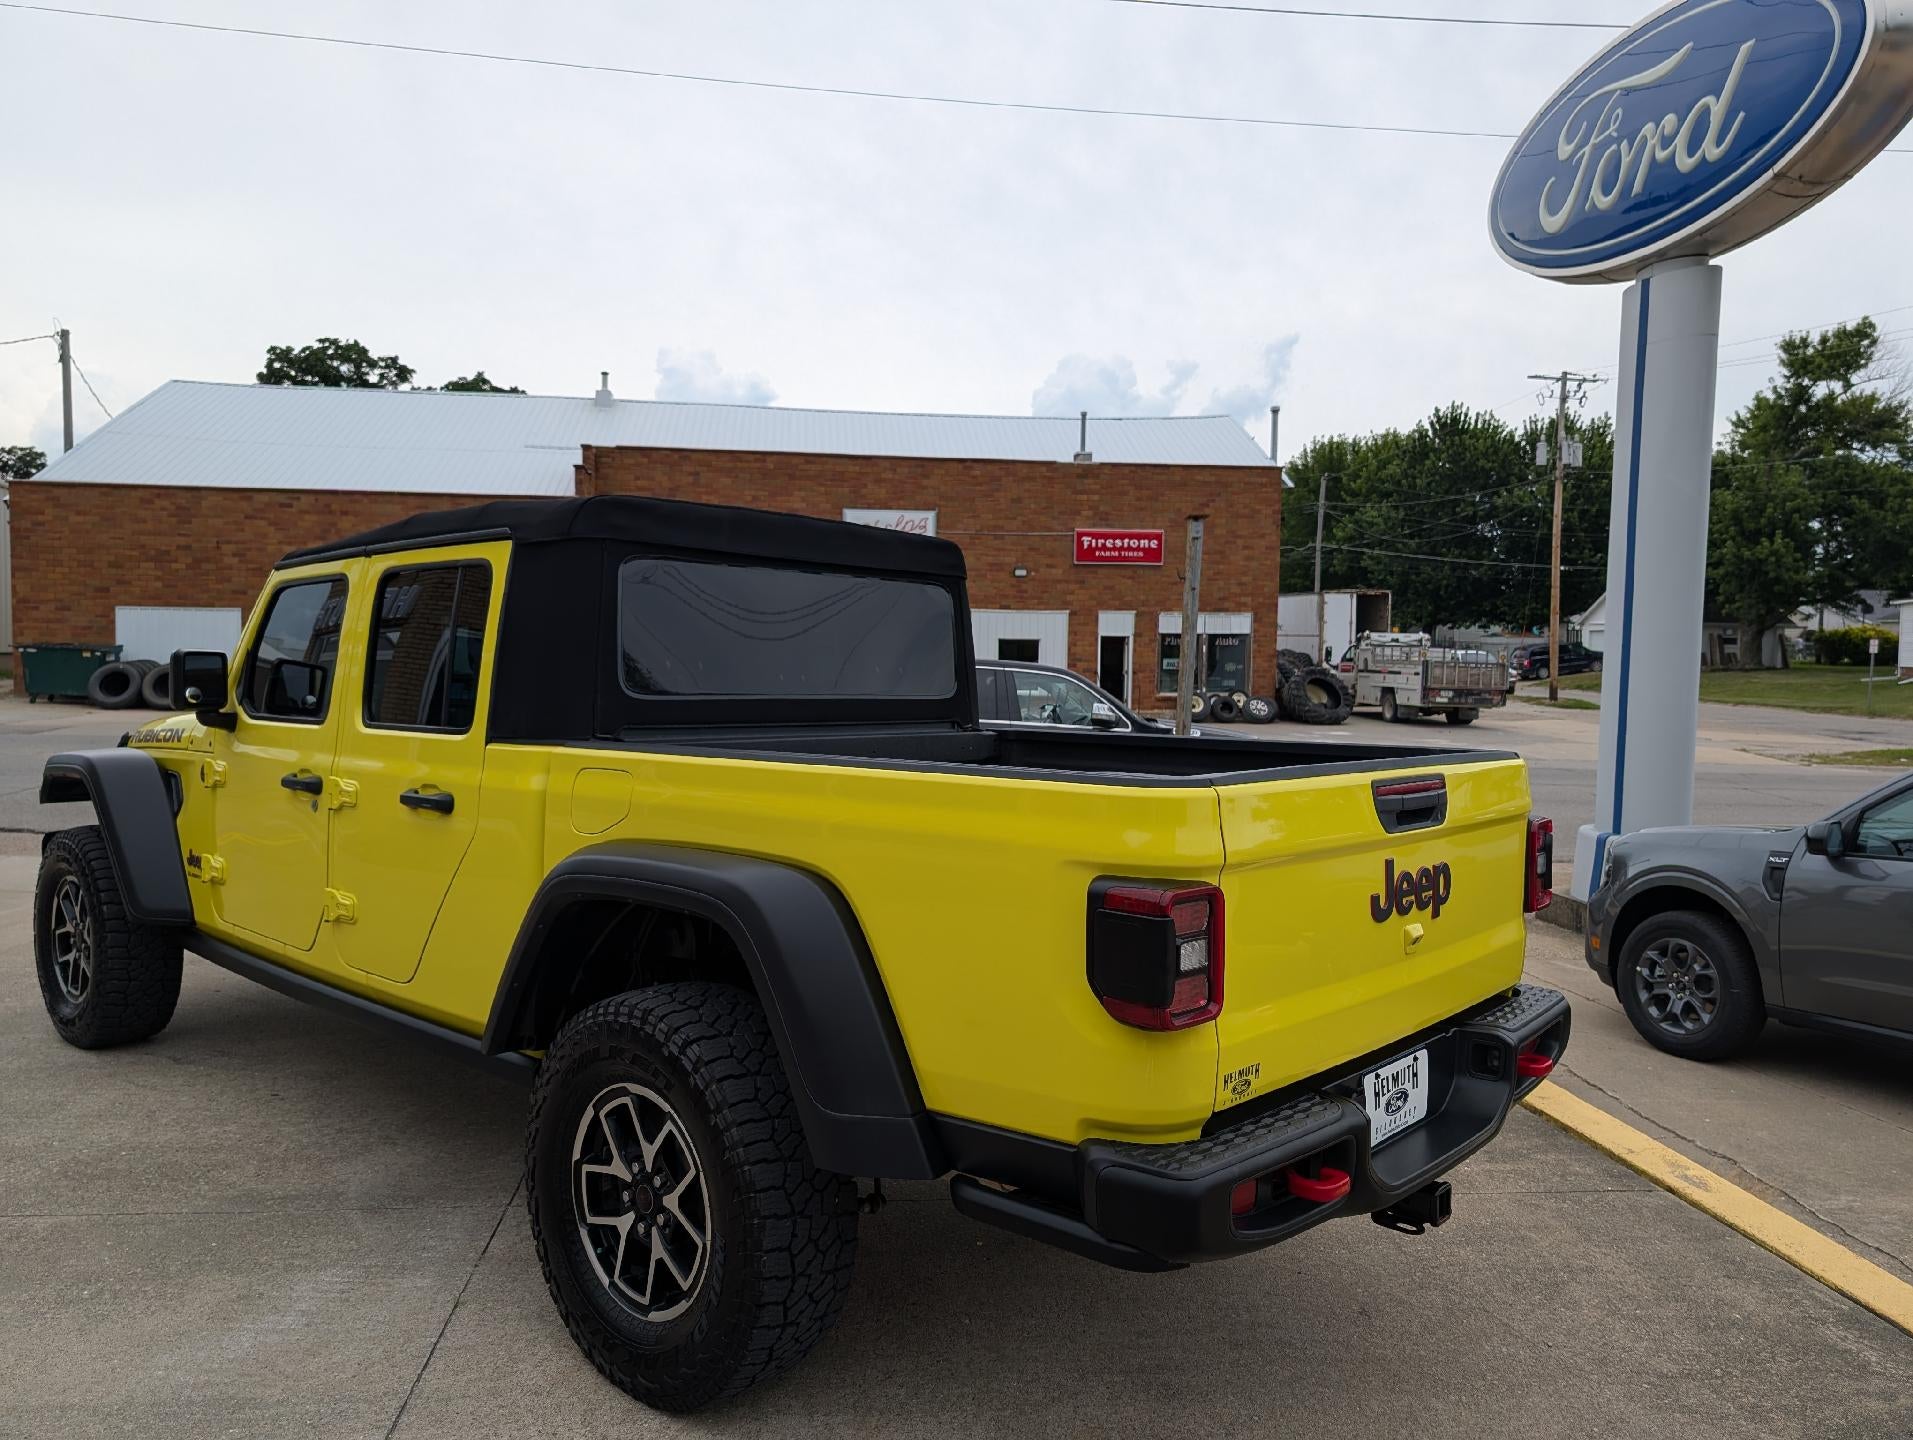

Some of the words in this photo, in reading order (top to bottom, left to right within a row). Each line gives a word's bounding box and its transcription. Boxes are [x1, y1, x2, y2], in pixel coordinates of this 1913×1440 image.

[1539, 38, 1757, 234] Ford
[1081, 536, 1158, 550] Firestone
[129, 728, 185, 743] RUBICON
[1370, 858, 1452, 924] Jeep
[1223, 1062, 1260, 1092] HELMUTH
[1374, 1062, 1419, 1112] HELMUTH
